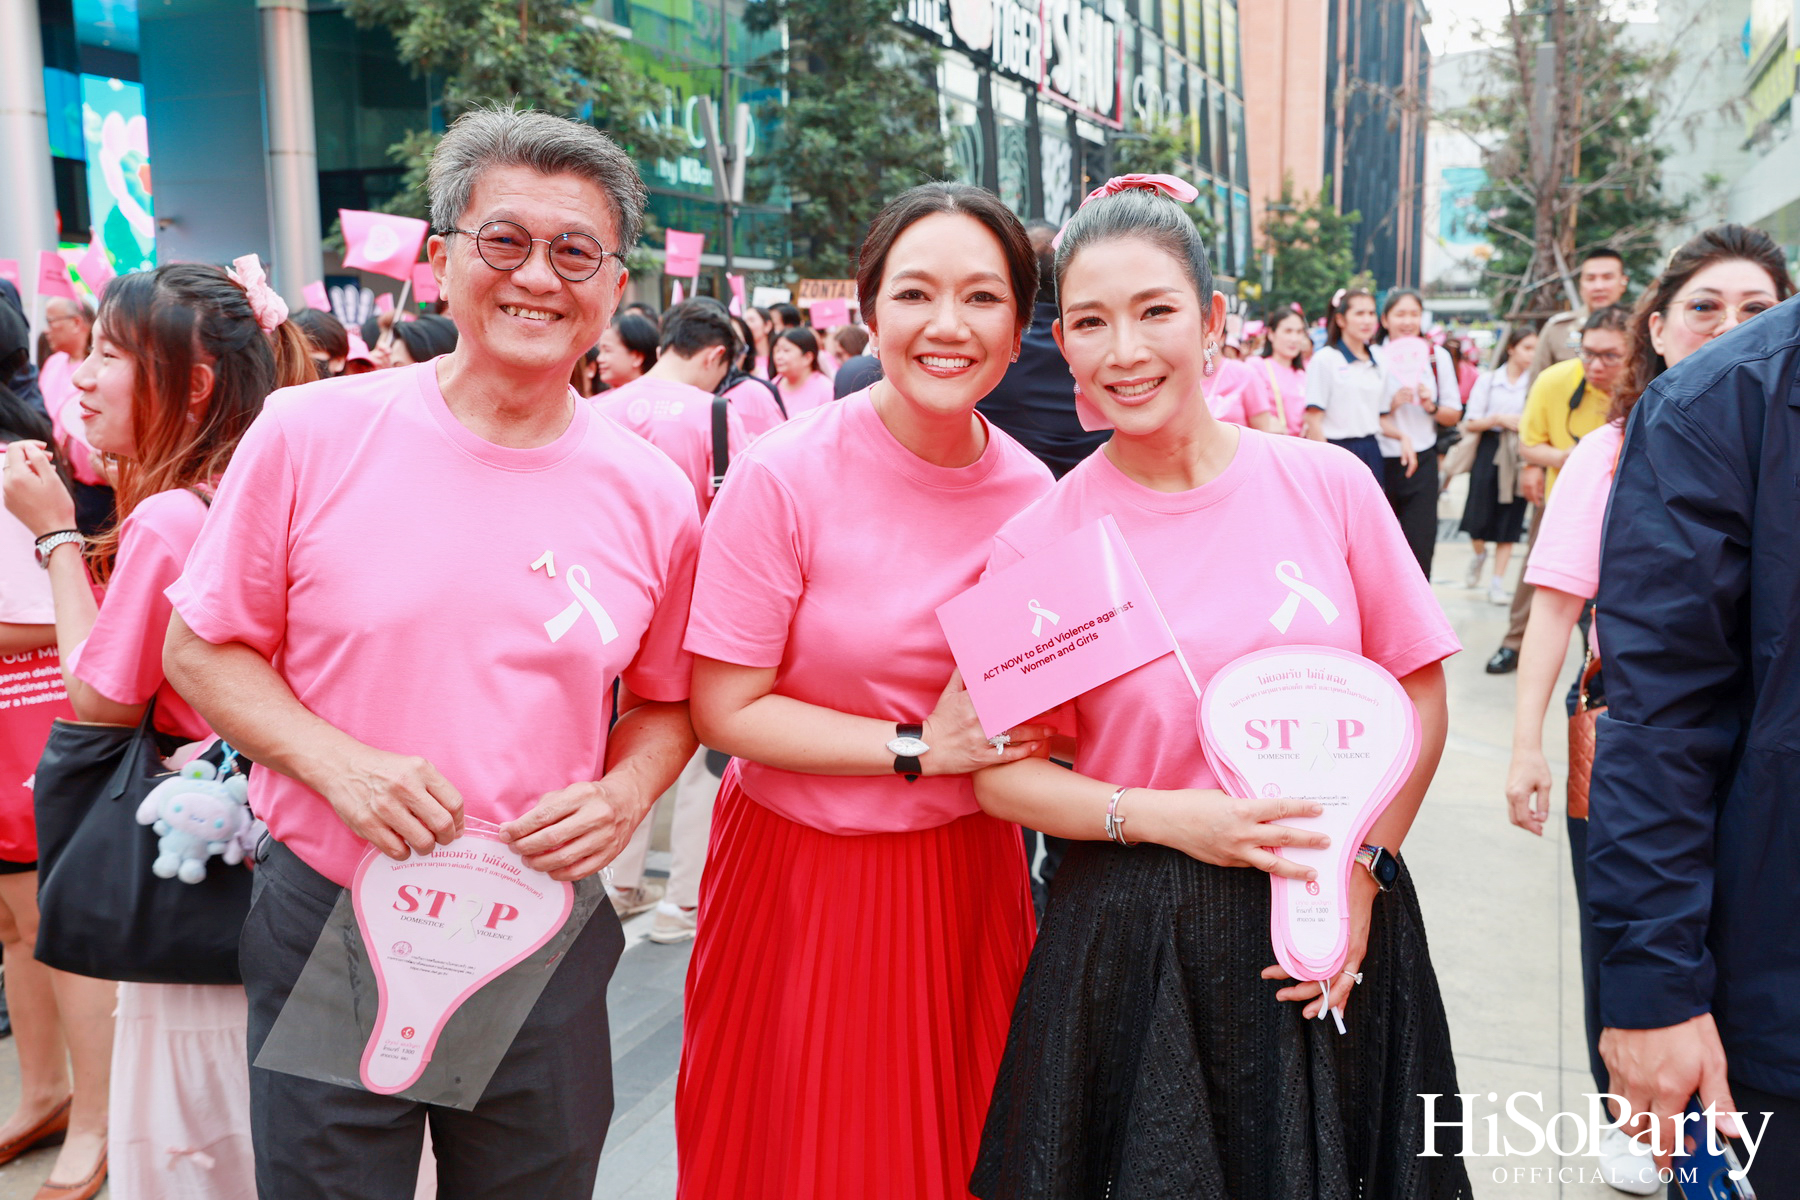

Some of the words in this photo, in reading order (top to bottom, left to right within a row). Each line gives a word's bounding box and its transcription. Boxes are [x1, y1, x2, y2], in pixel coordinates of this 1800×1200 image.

[799, 281, 847, 297] ZONTA
[38, 647, 59, 659] Mi
[983, 667, 1000, 682] ACT
[1000, 654, 1024, 672] NOW
[1024, 649, 1035, 660] to
[1035, 639, 1055, 654] End
[1054, 620, 1095, 644] Violence
[1096, 601, 1134, 624] against
[1020, 654, 1057, 675] Women
[1057, 642, 1076, 657] and
[1076, 631, 1099, 647] Girls
[400, 914, 444, 929] DOMESTICE
[476, 928, 513, 941] VIOLENCE
